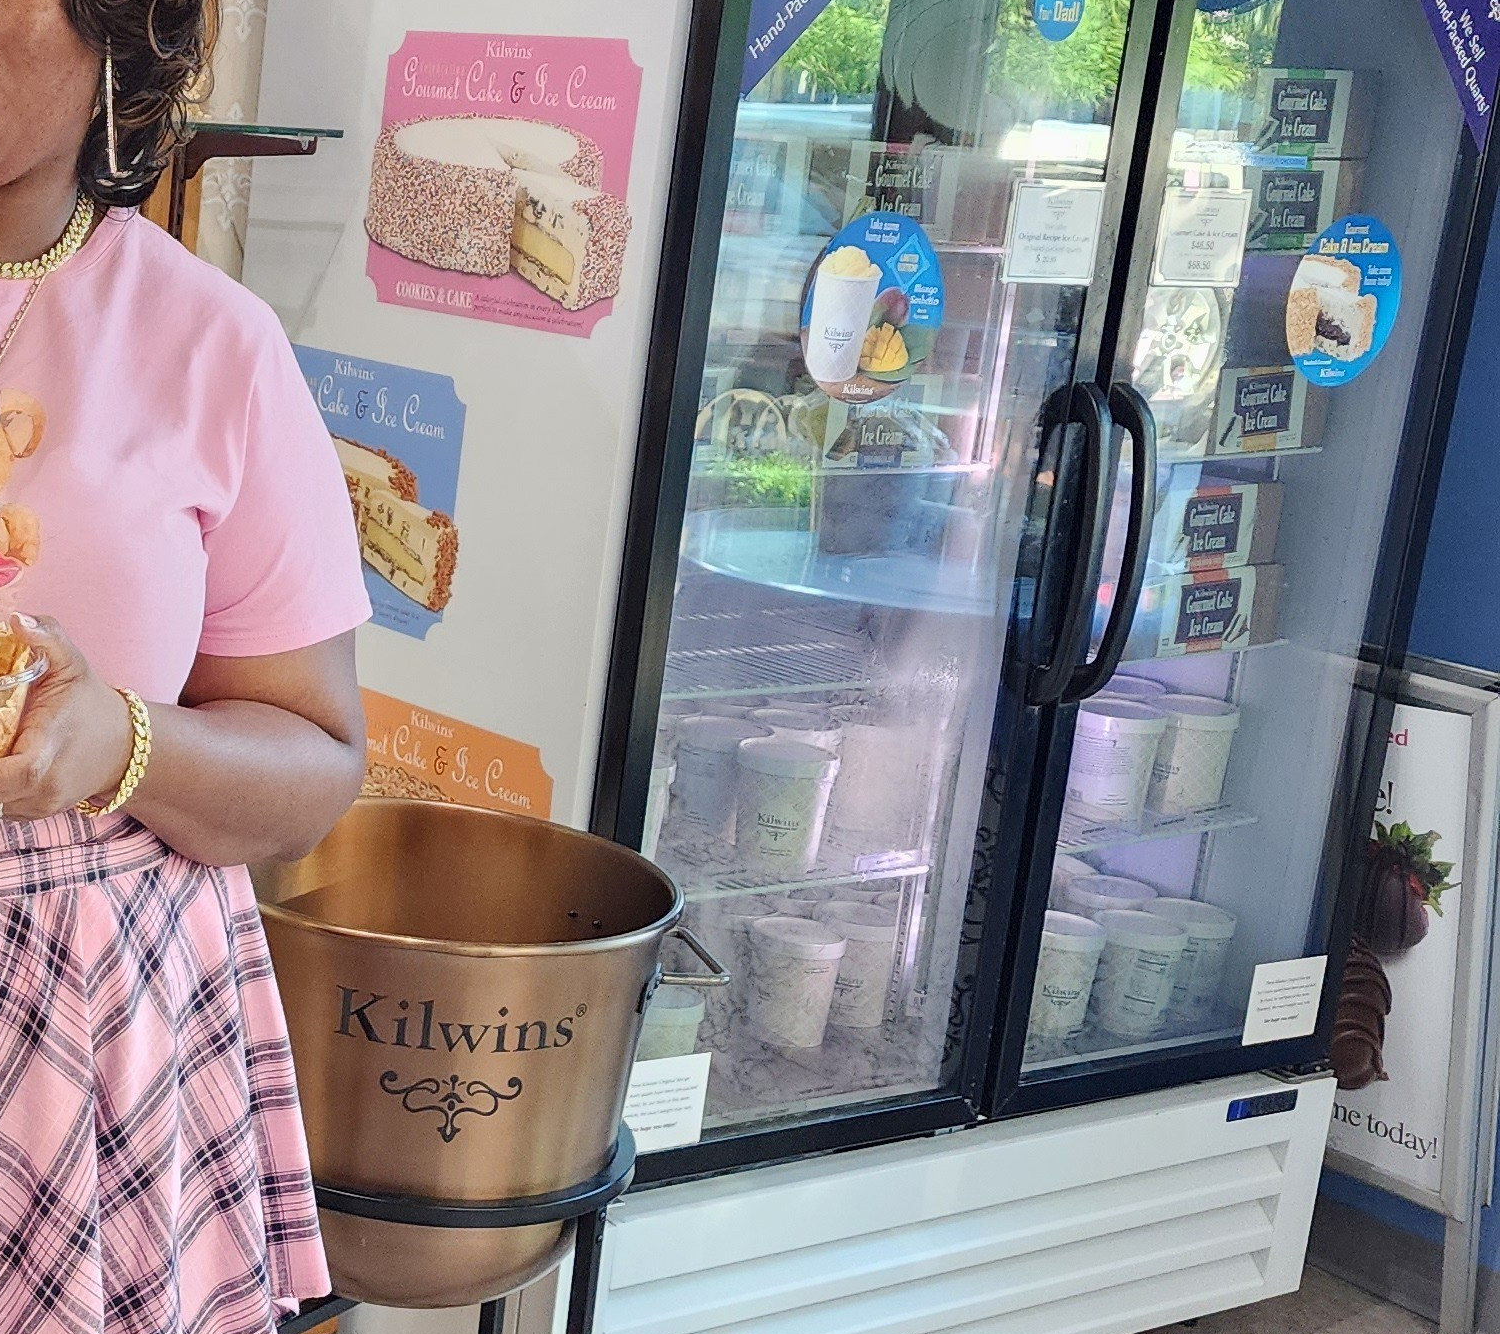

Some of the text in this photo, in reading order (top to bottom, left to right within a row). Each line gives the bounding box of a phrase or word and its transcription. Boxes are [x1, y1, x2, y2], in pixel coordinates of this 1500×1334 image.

[1053, 1, 1080, 22] Dad!
[486, 40, 533, 60] Kilwins
[1459, 8, 1486, 63] We Sell
[402, 56, 617, 111] Gourmet Cake & Ice Cream
[1465, 66, 1490, 117] Quarts!
[1319, 238, 1340, 253] Cake
[396, 281, 473, 309] COOKIES & CAKE
[334, 358, 376, 380] Kilwins
[318, 375, 445, 439] Cake & Ice Cream
[411, 710, 454, 738] Kilwins
[393, 725, 427, 770] Cake
[434, 746, 448, 775] &
[452, 746, 479, 790] Ice
[485, 758, 531, 809] Cream
[1367, 1113, 1438, 1159] today!
